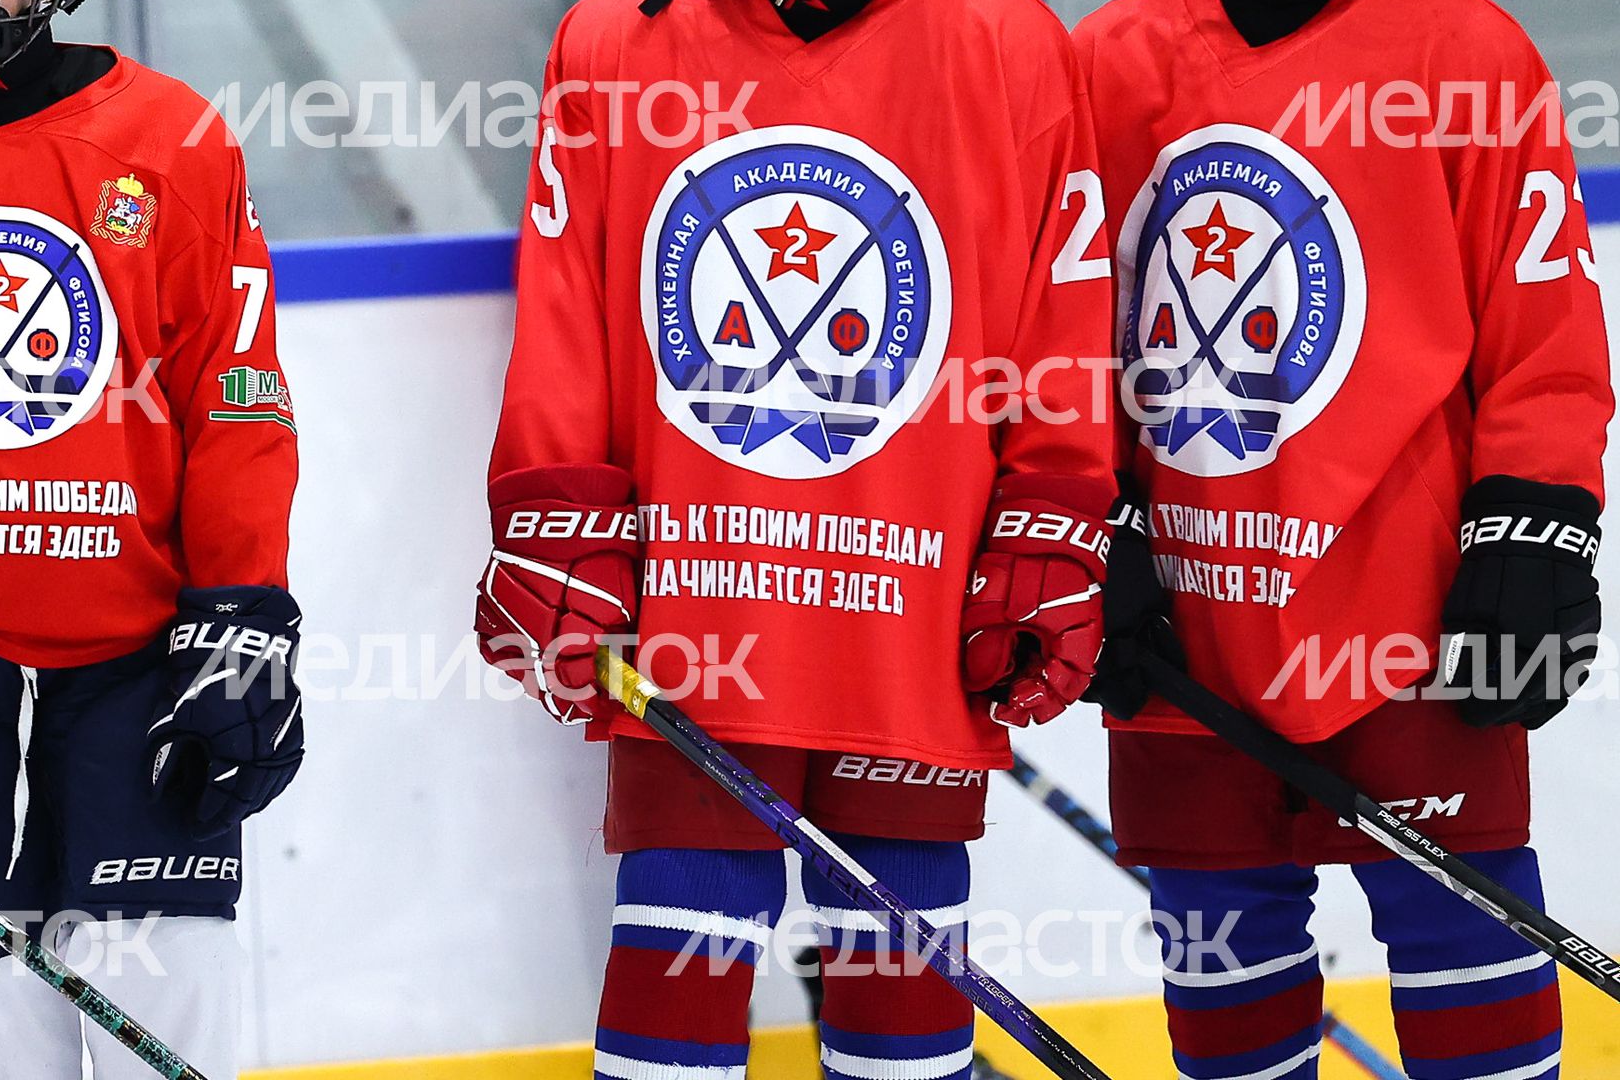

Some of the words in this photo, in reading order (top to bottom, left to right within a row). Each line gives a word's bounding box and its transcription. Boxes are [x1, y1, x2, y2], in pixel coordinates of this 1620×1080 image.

[782, 226, 809, 266] 2
[1051, 168, 1112, 284] 2
[1206, 225, 1229, 263] 2
[661, 210, 702, 363] ХОККЕЙНАЯ
[732, 160, 868, 201] АКАДЕМИЯ
[882, 239, 921, 373] ФЕТИСОВА
[1171, 160, 1283, 199] АКАДЕМИЯ
[1289, 240, 1329, 369] ФЕТИСОВА
[67, 276, 93, 370] ФЕТИСОВА
[231, 265, 270, 355] 7
[713, 299, 756, 350] А
[827, 306, 871, 357] Ф
[1146, 302, 1178, 349] А
[27, 328, 59, 362] Ф
[45, 524, 122, 560] ЗДЕСЬ
[504, 510, 638, 540] BAUE
[687, 504, 708, 542] К
[712, 504, 812, 551] ТВОИМ
[815, 513, 945, 569] ПОБЕДАМ
[991, 510, 1112, 568] BAUE
[1460, 516, 1600, 565] BAUER
[642, 558, 824, 607] НАЧИНАЕТСЯ
[828, 569, 905, 617] ЗДЕСЬ
[831, 754, 985, 788] BAUER
[89, 855, 240, 885] BAUER
[1418, 838, 1450, 862] FLEX
